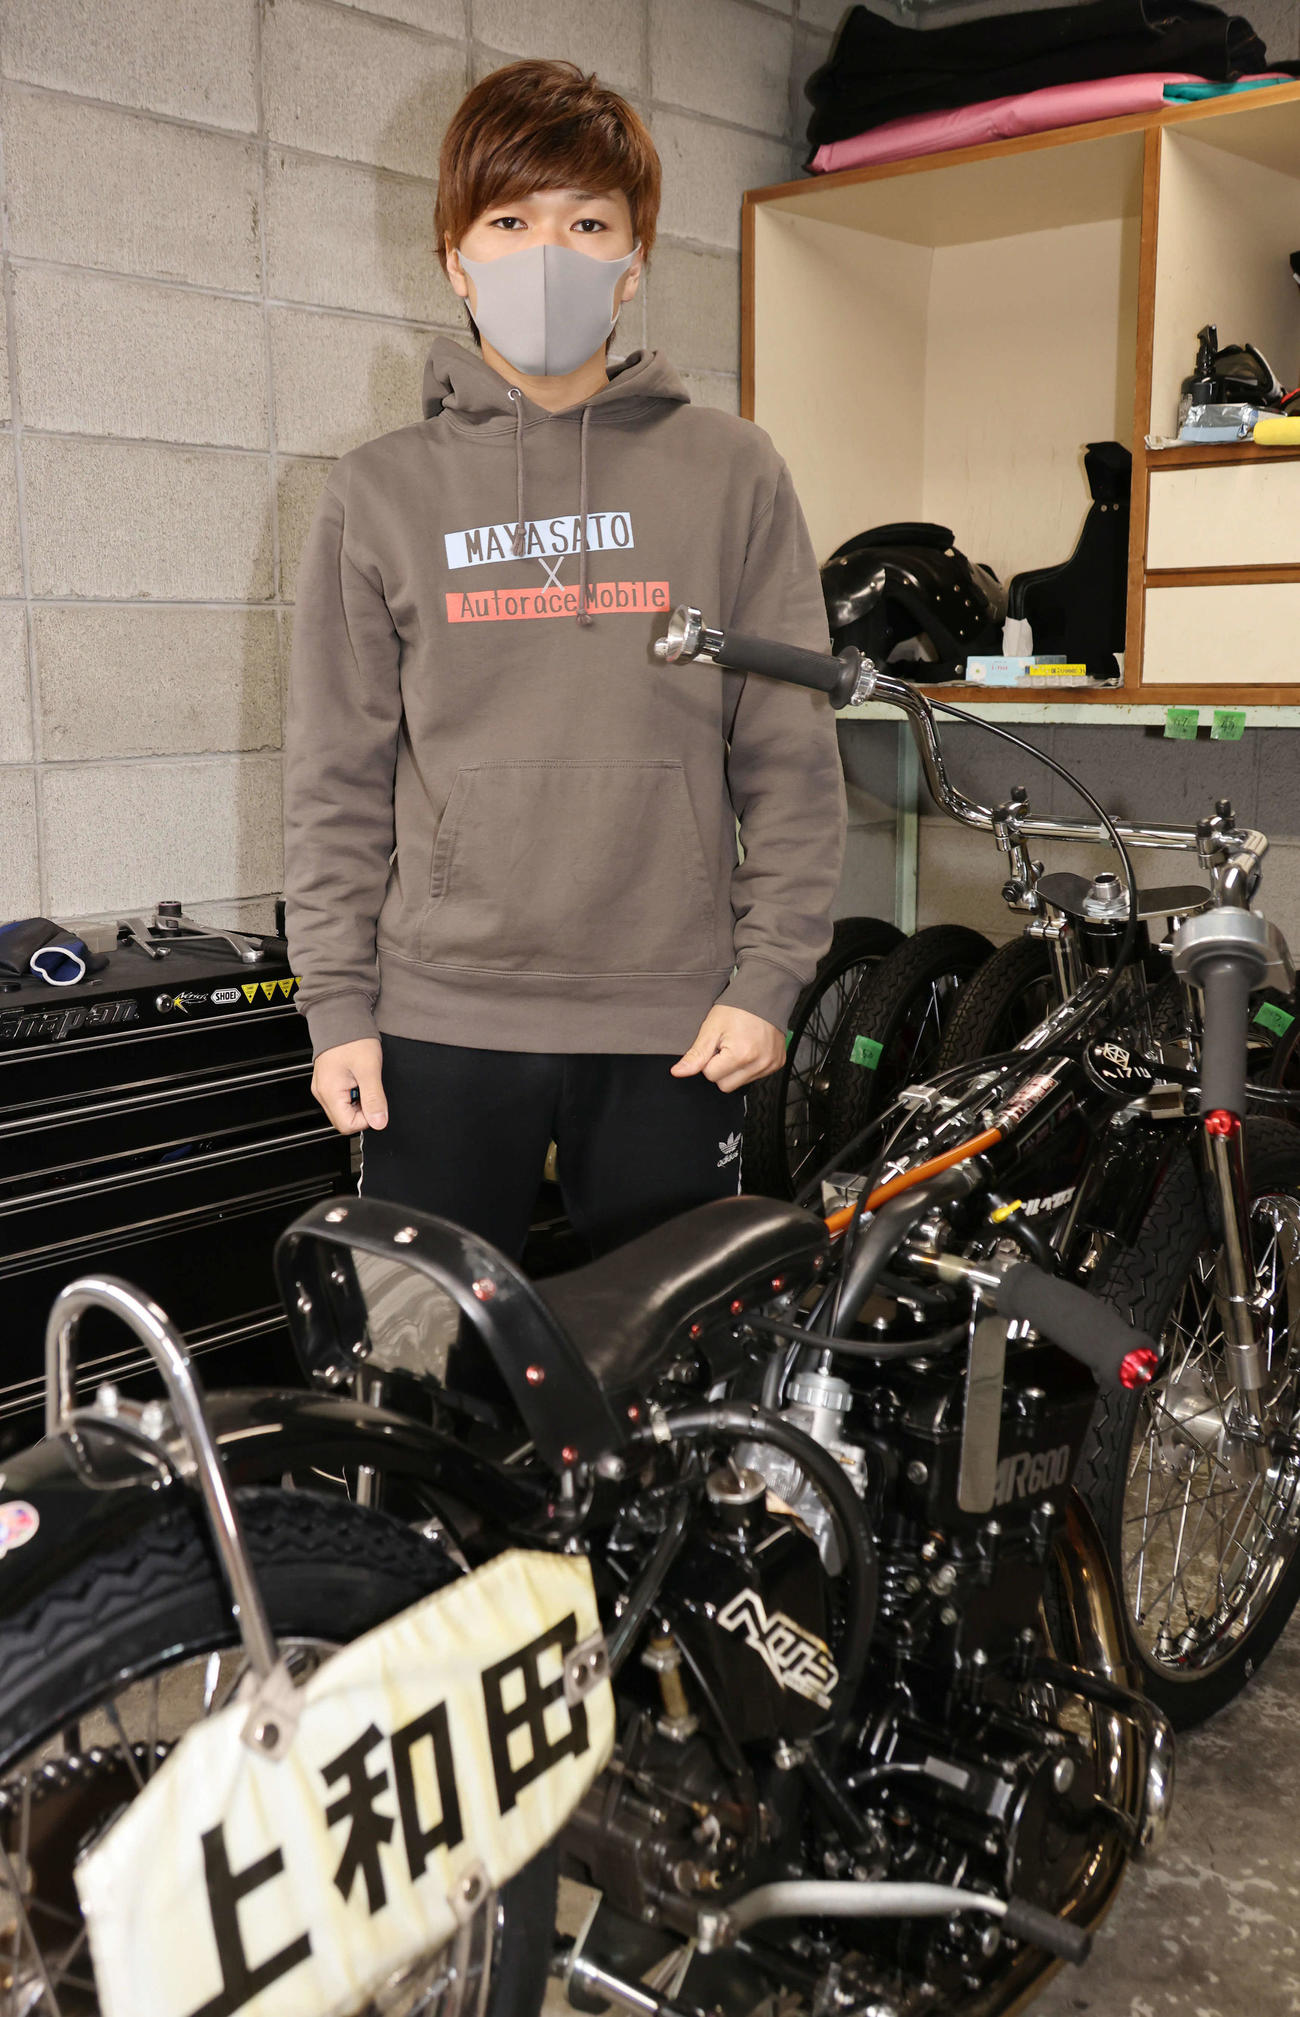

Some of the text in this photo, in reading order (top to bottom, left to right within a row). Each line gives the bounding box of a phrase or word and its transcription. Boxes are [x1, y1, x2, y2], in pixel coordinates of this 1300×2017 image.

[215, 991, 237, 1001] SHOEI
[190, 1611, 590, 2017] 上和田
